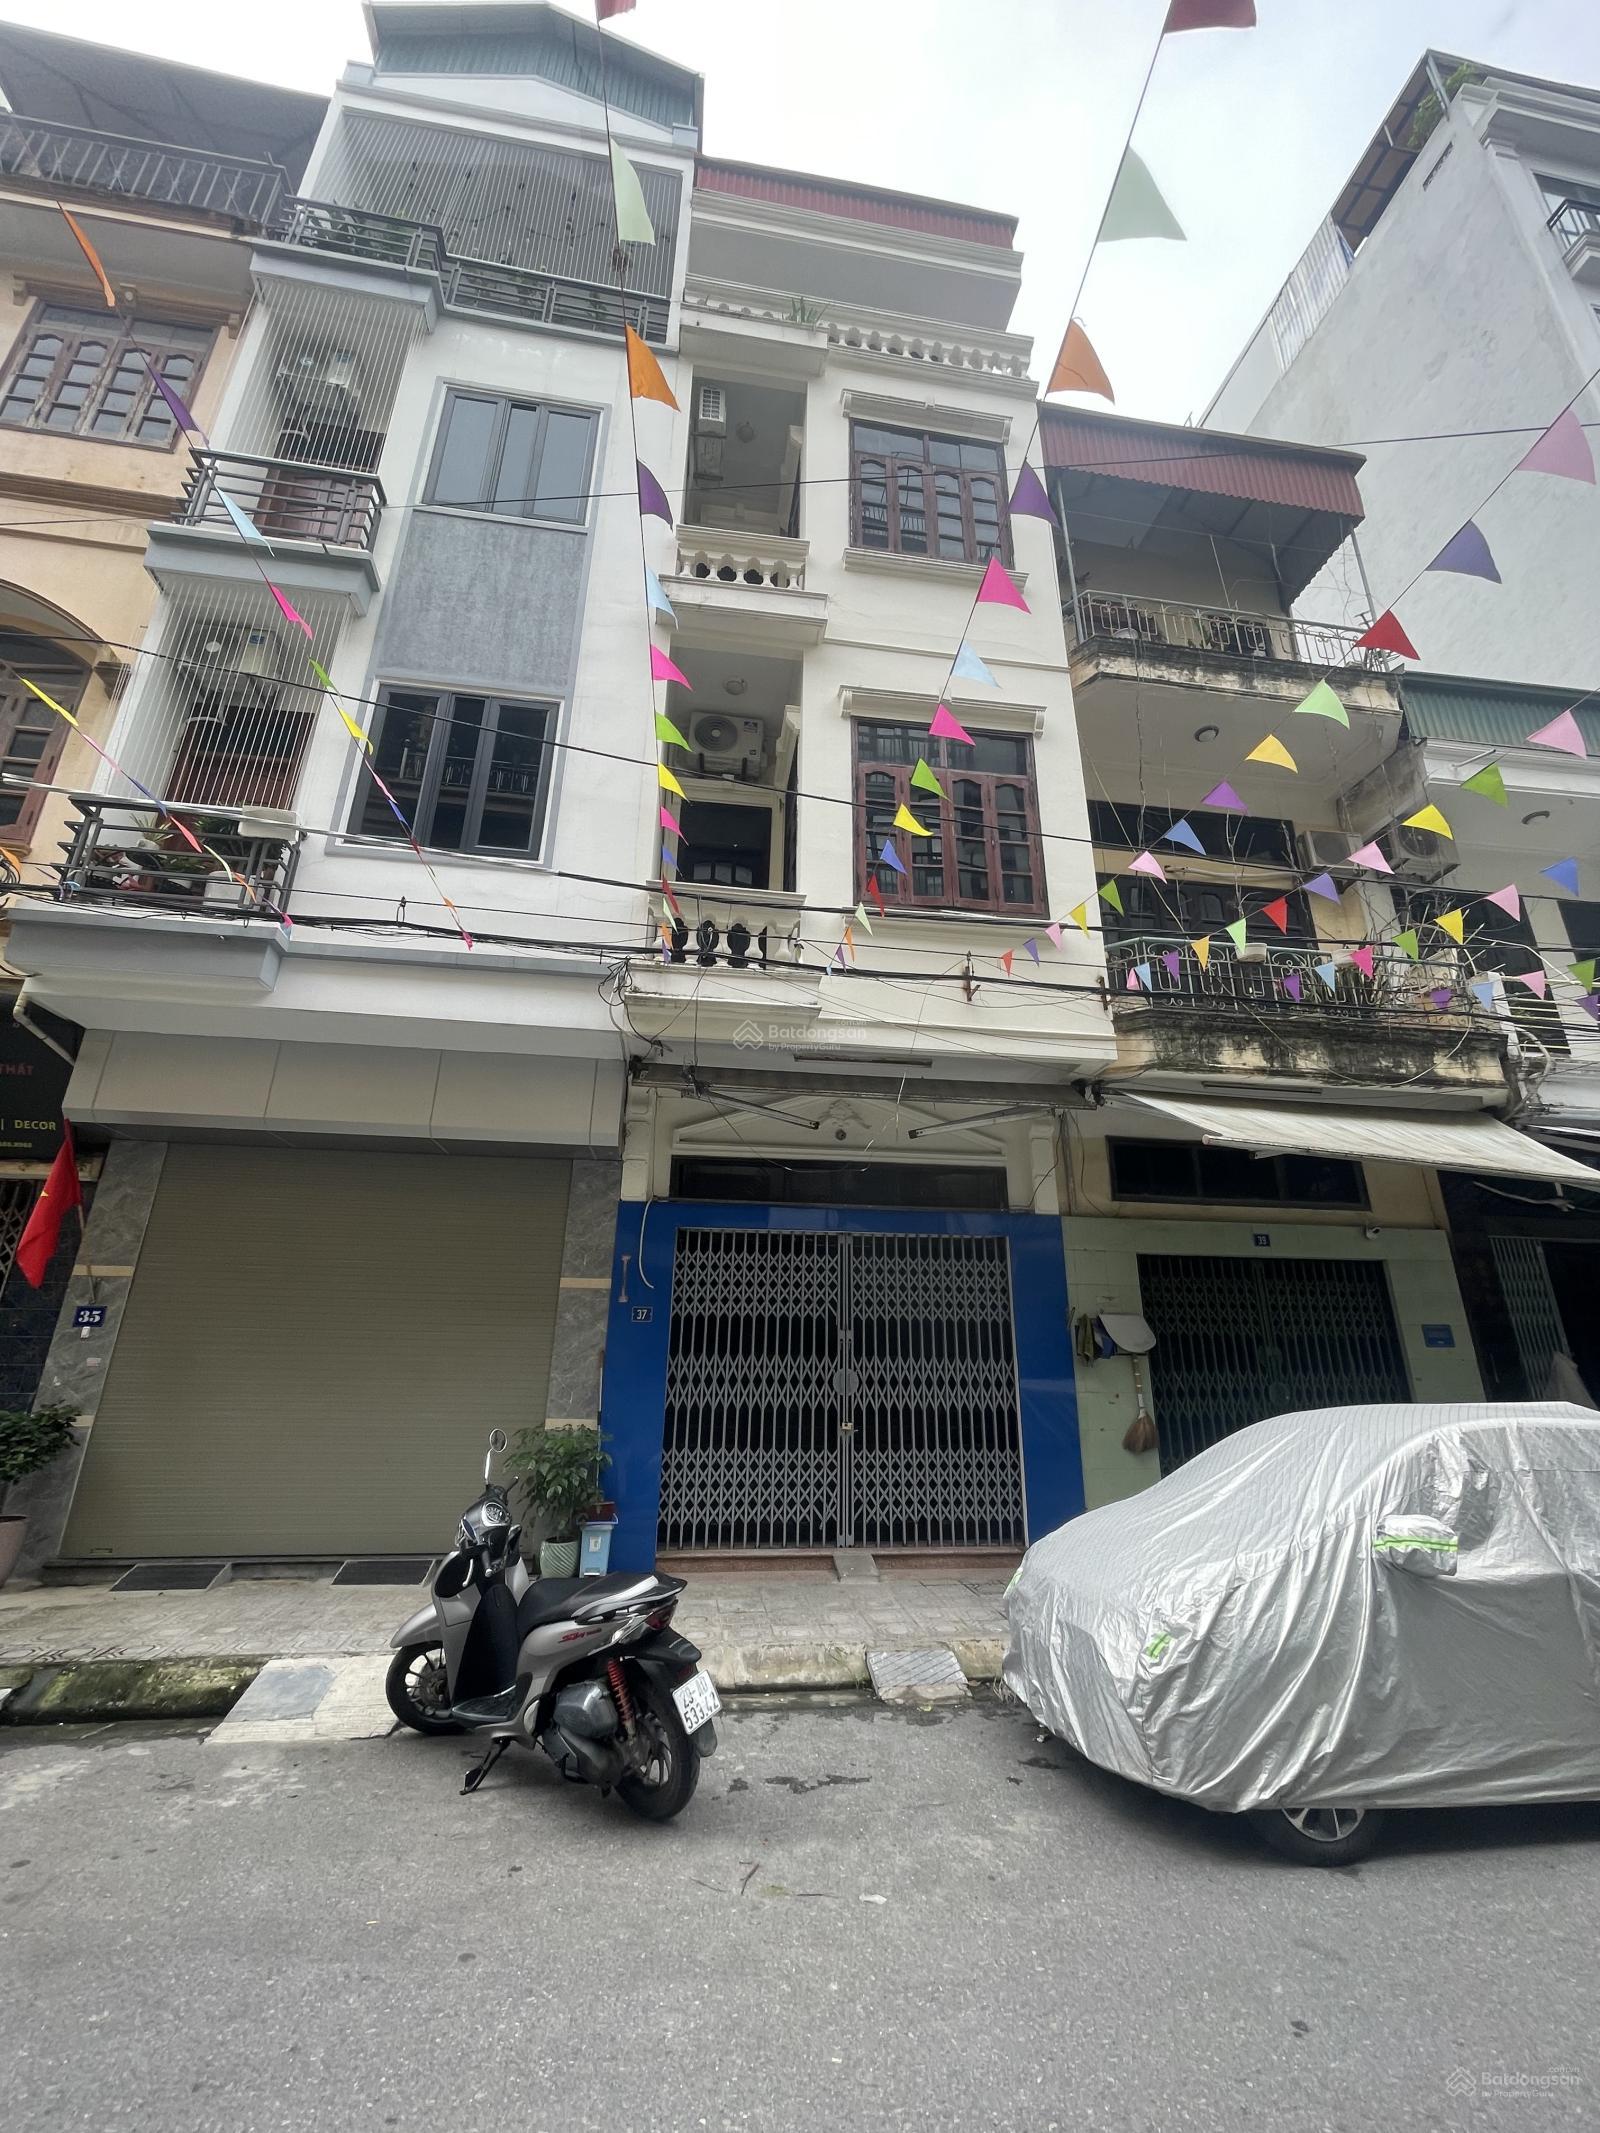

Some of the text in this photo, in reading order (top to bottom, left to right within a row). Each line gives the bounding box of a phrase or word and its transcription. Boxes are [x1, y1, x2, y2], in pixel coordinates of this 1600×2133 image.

[14, 1120, 56, 1131] DECOR
[78, 1310, 102, 1322] 35
[636, 1309, 648, 1320] 37
